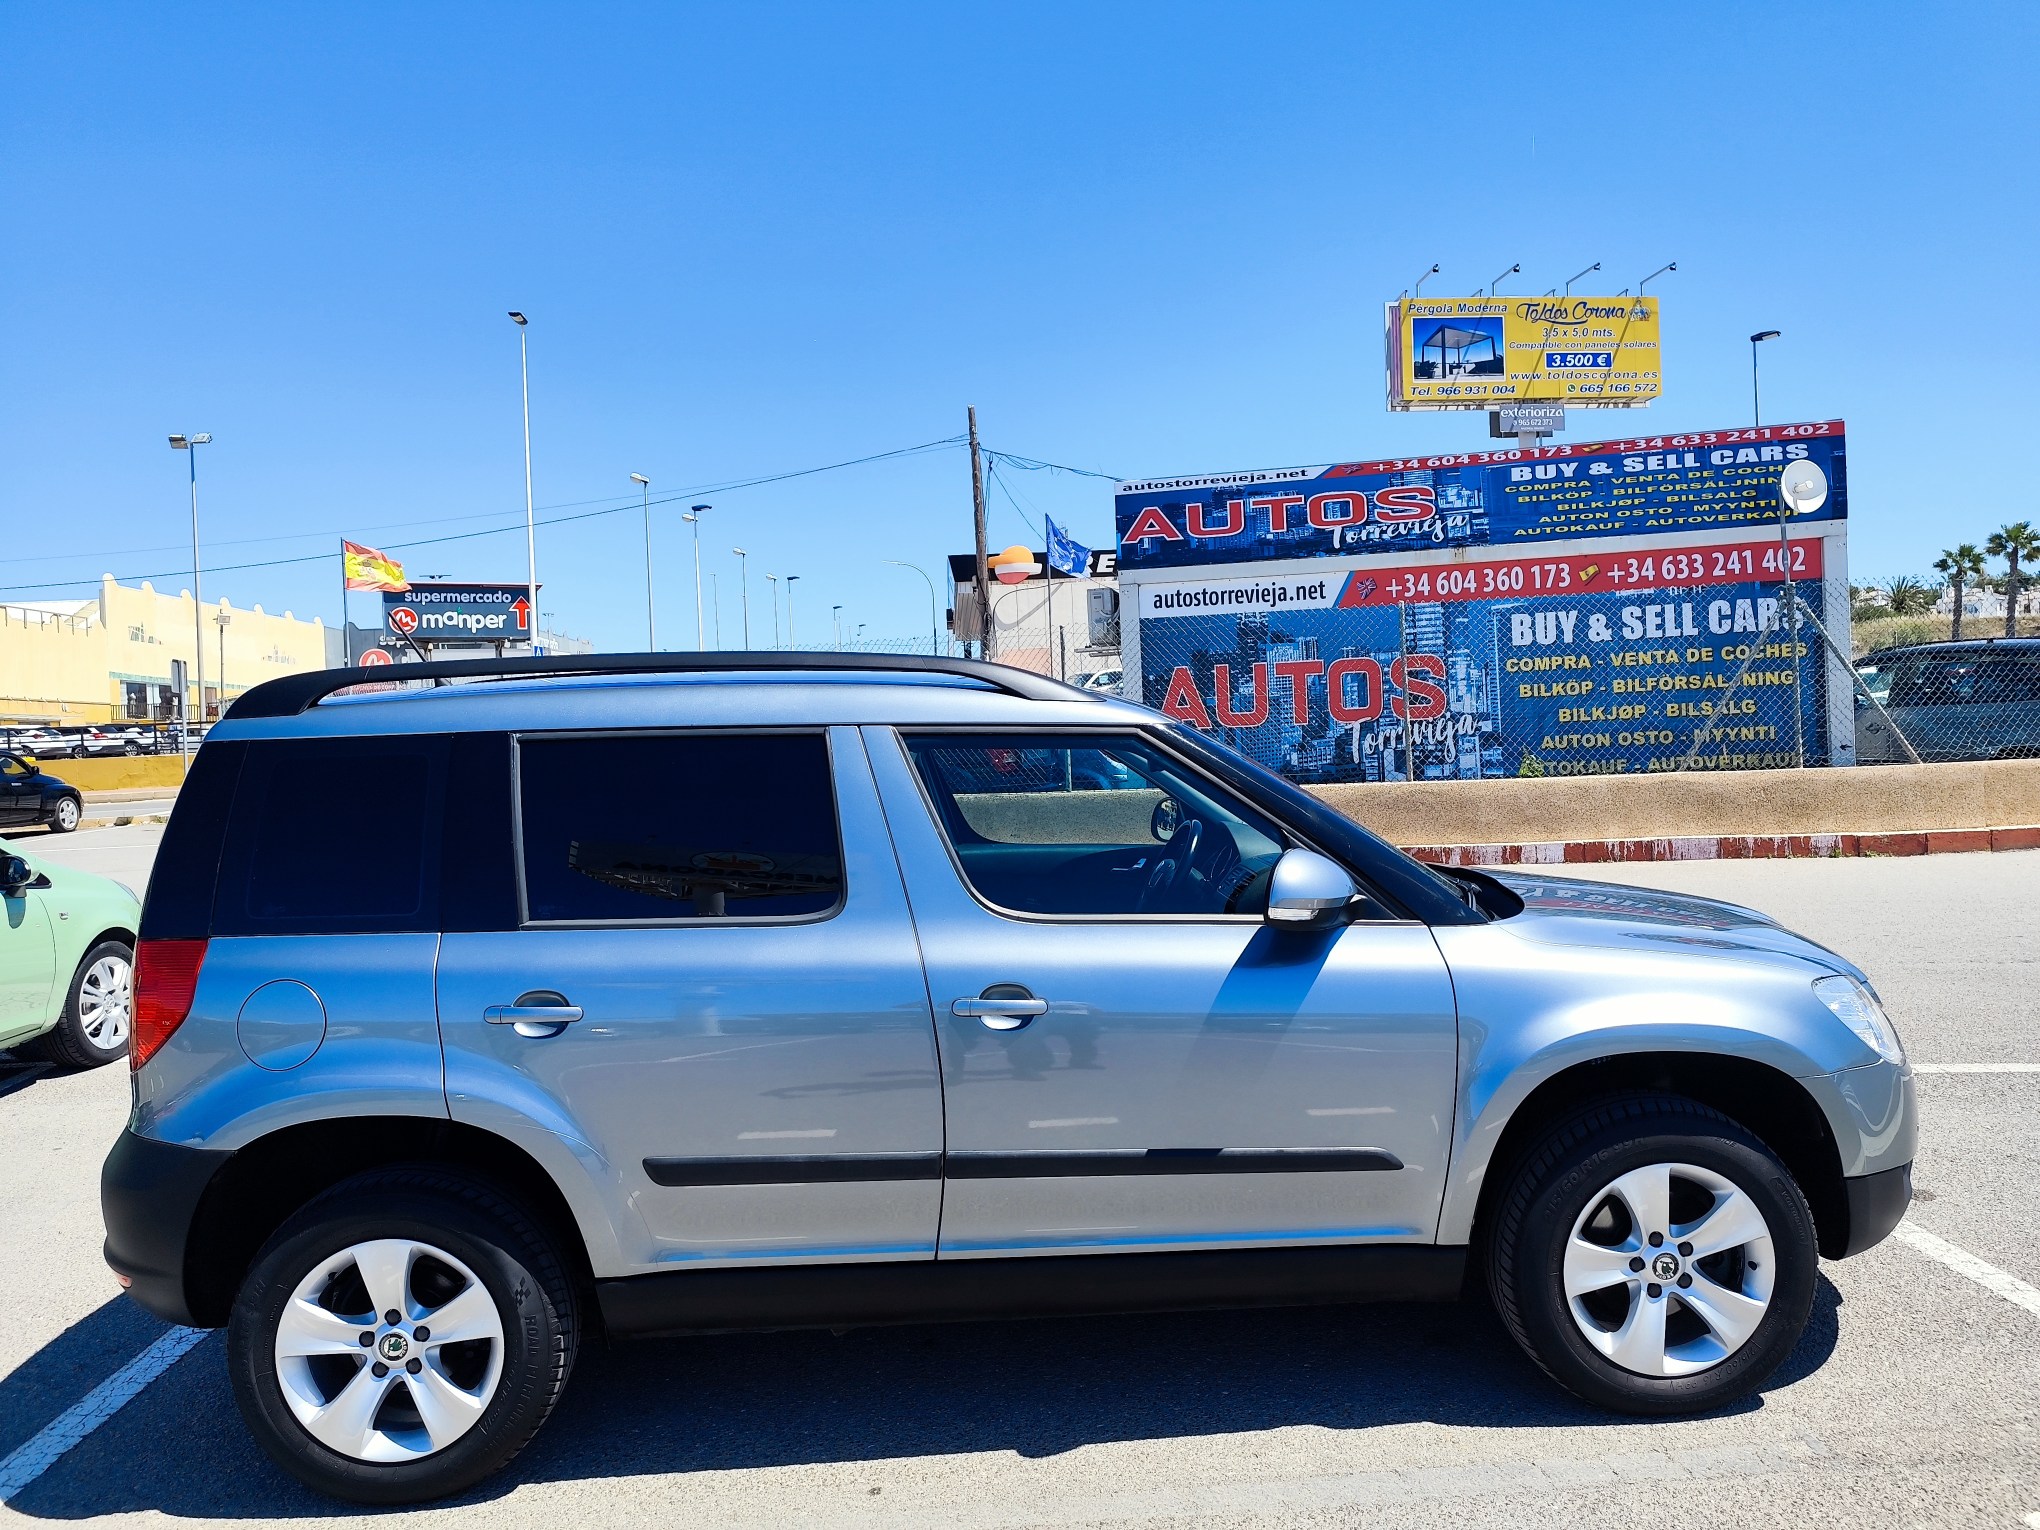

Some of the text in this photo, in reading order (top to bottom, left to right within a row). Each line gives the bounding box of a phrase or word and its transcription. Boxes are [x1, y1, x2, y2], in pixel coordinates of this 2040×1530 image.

[1457, 303, 1508, 314] Moderna
[1516, 301, 1626, 323] Toldos Corona
[1572, 327, 1589, 338] 5,0
[1592, 327, 1616, 337] mts.
[1509, 342, 1562, 350] Compatible
[1585, 341, 1621, 350] paneles
[1624, 340, 1657, 348] solares
[1552, 354, 1608, 366] 3.500 €
[1510, 371, 1658, 380] www.toldoscorona.es
[1411, 385, 1516, 396] Tel. 966 931 004
[1580, 383, 1658, 393] 665 166 572
[1501, 406, 1564, 419] exterioriza
[1372, 424, 1830, 472] +34 604 360 173 +34 633 241 402
[1511, 443, 1809, 482] BUY & SELL CARS
[1122, 468, 1308, 492] autostorrevieja.net
[1504, 480, 1591, 493] COMPRA
[1611, 472, 1680, 485] VENTA
[1688, 470, 1715, 478] DE
[1722, 465, 1788, 476] COCH
[1517, 490, 1593, 503] BILKÖP
[1612, 476, 1780, 496] BILFÖRSÄLJNIN
[1538, 511, 1609, 523] AUTON
[1616, 506, 1673, 517] OSTO
[1693, 499, 1777, 512] MYYNTI
[1557, 497, 1646, 511] BILKJØP
[1666, 489, 1757, 503] BILSALG
[1121, 485, 1437, 545] AUTOS
[1325, 513, 1469, 549] Torrevieja
[1514, 521, 1625, 536] AUTOKAUF
[1385, 546, 1806, 597] +34 604 360 173 +34 633 241 402
[404, 590, 512, 606] supermercado
[1153, 581, 1326, 609] autostorrevieja.net
[422, 611, 508, 634] manper
[1511, 611, 1578, 646] BUY
[1588, 612, 1612, 641] &
[1622, 601, 1699, 639] SELL
[1506, 655, 1591, 672] COMPRA
[1611, 650, 1679, 667] VENTA
[1687, 647, 1713, 662] DE
[1162, 653, 1447, 729] AUTOS
[1519, 680, 1593, 698] BILKÖP
[1613, 670, 1794, 693] BILFÖRSÄLNING
[1559, 704, 1646, 722] BILKJØP
[1349, 711, 1477, 764] Torrvieja
[1541, 733, 1611, 749] AUTON
[1618, 730, 1673, 746] OSTO
[1694, 726, 1777, 742] MYYNTI
[1544, 758, 1628, 775] TOKAUF
